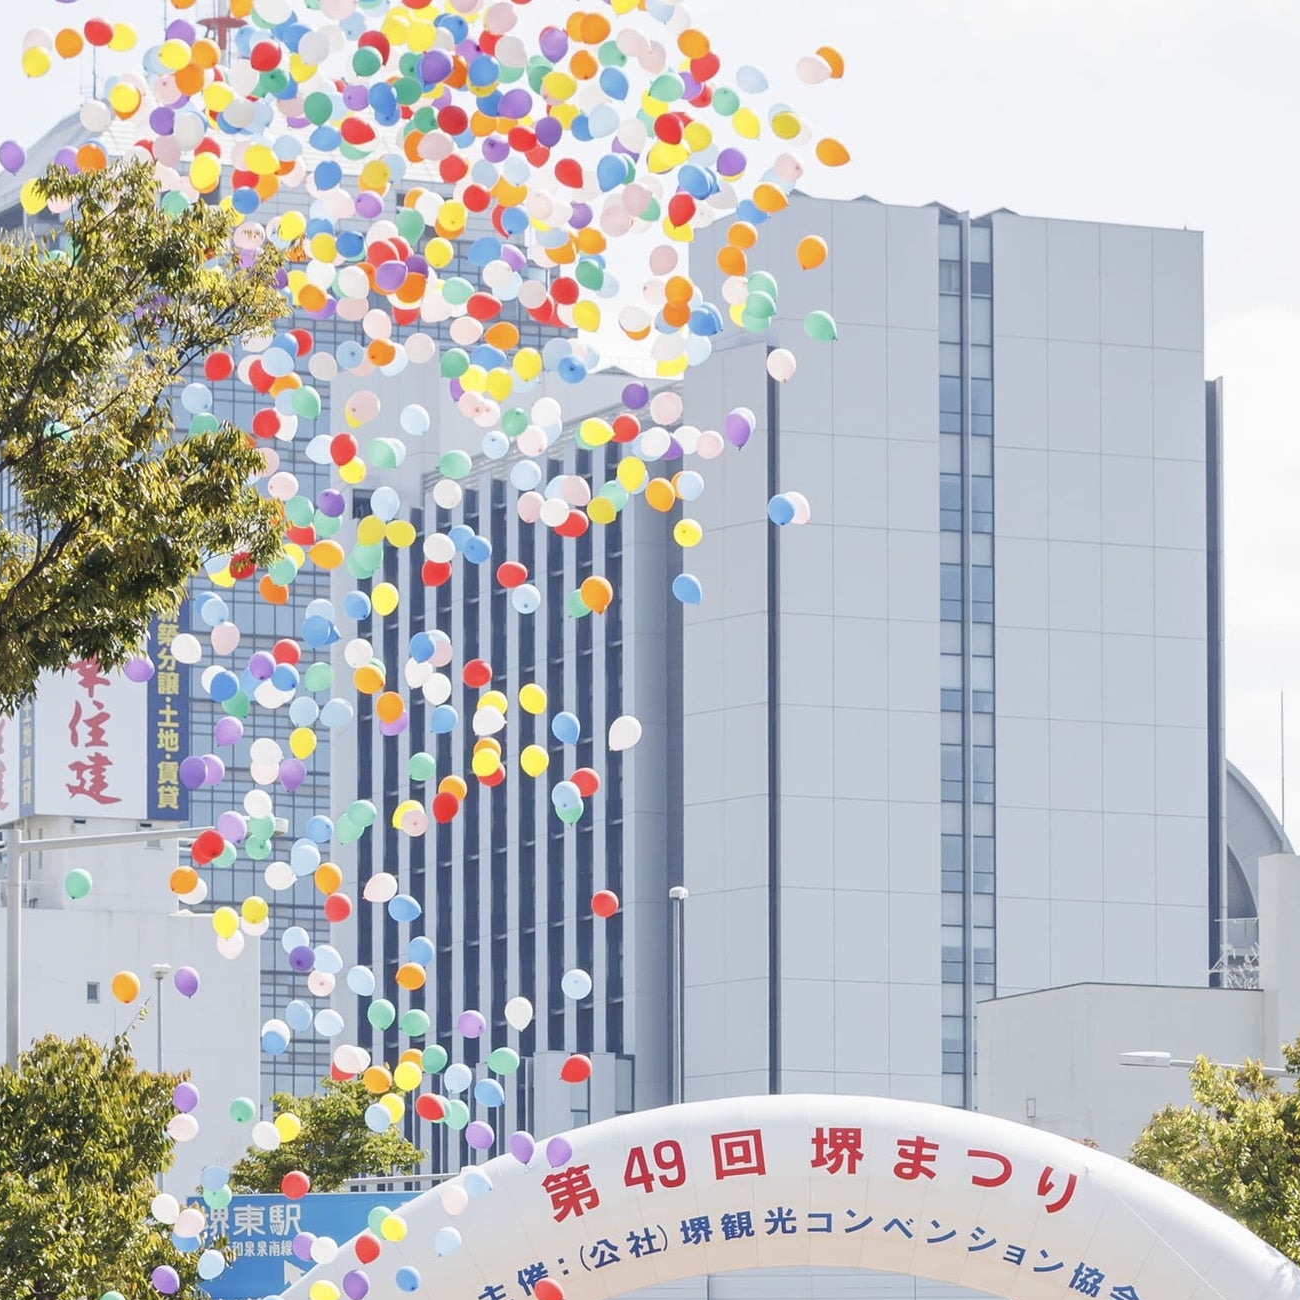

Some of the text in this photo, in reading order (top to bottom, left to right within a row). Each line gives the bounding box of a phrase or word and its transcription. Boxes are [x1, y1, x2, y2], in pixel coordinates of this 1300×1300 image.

[541, 1126, 1080, 1224] 第49回 堺まつり
